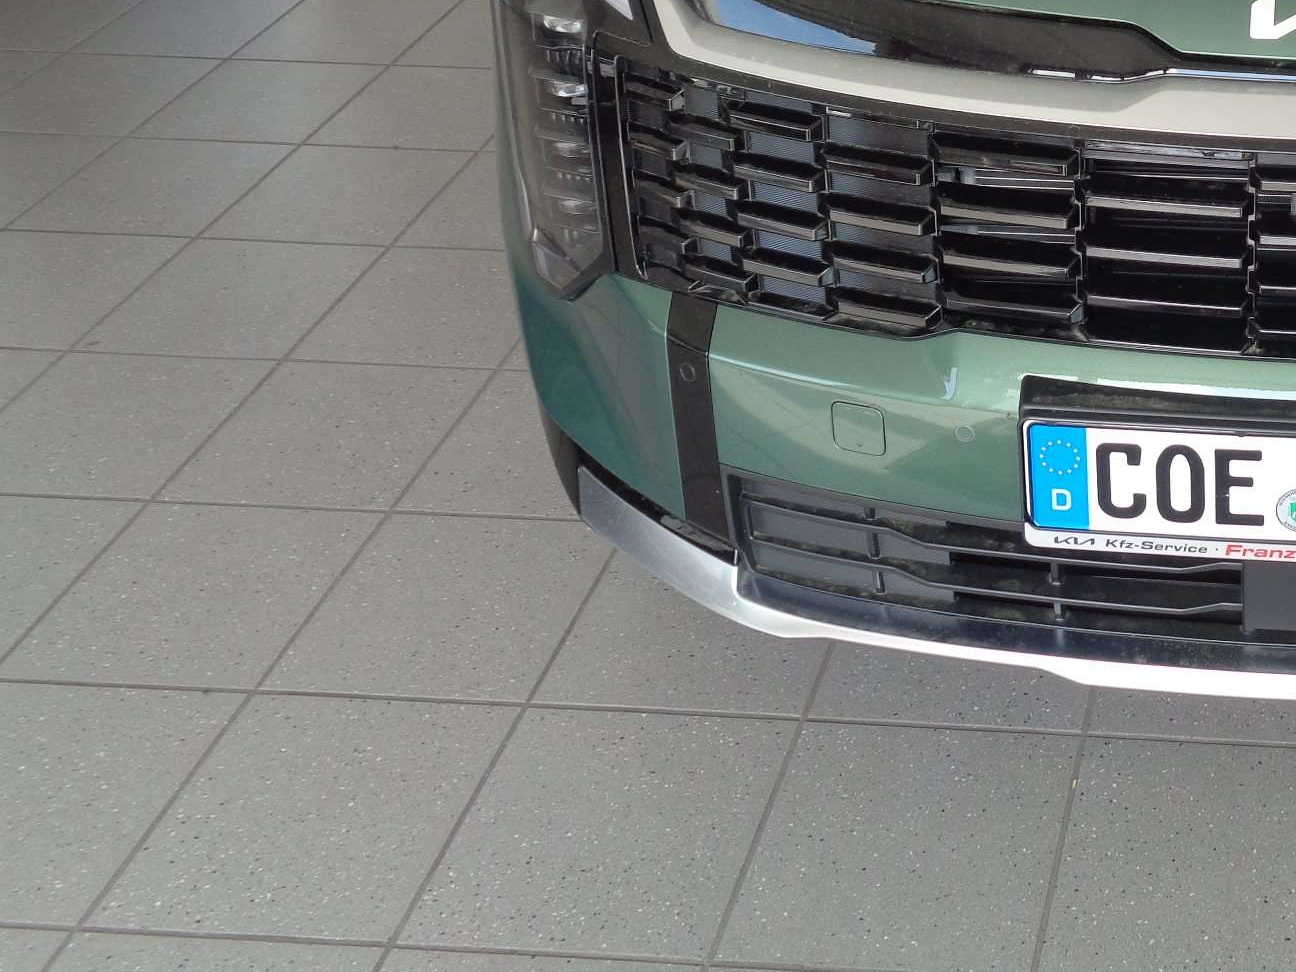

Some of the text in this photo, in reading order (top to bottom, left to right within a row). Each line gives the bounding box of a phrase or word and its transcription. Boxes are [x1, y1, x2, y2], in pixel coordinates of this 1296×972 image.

[1095, 442, 1264, 526] COE
[1051, 488, 1072, 511] D
[1054, 536, 1095, 546] KIA
[1105, 538, 1208, 554] Kfz-Service
